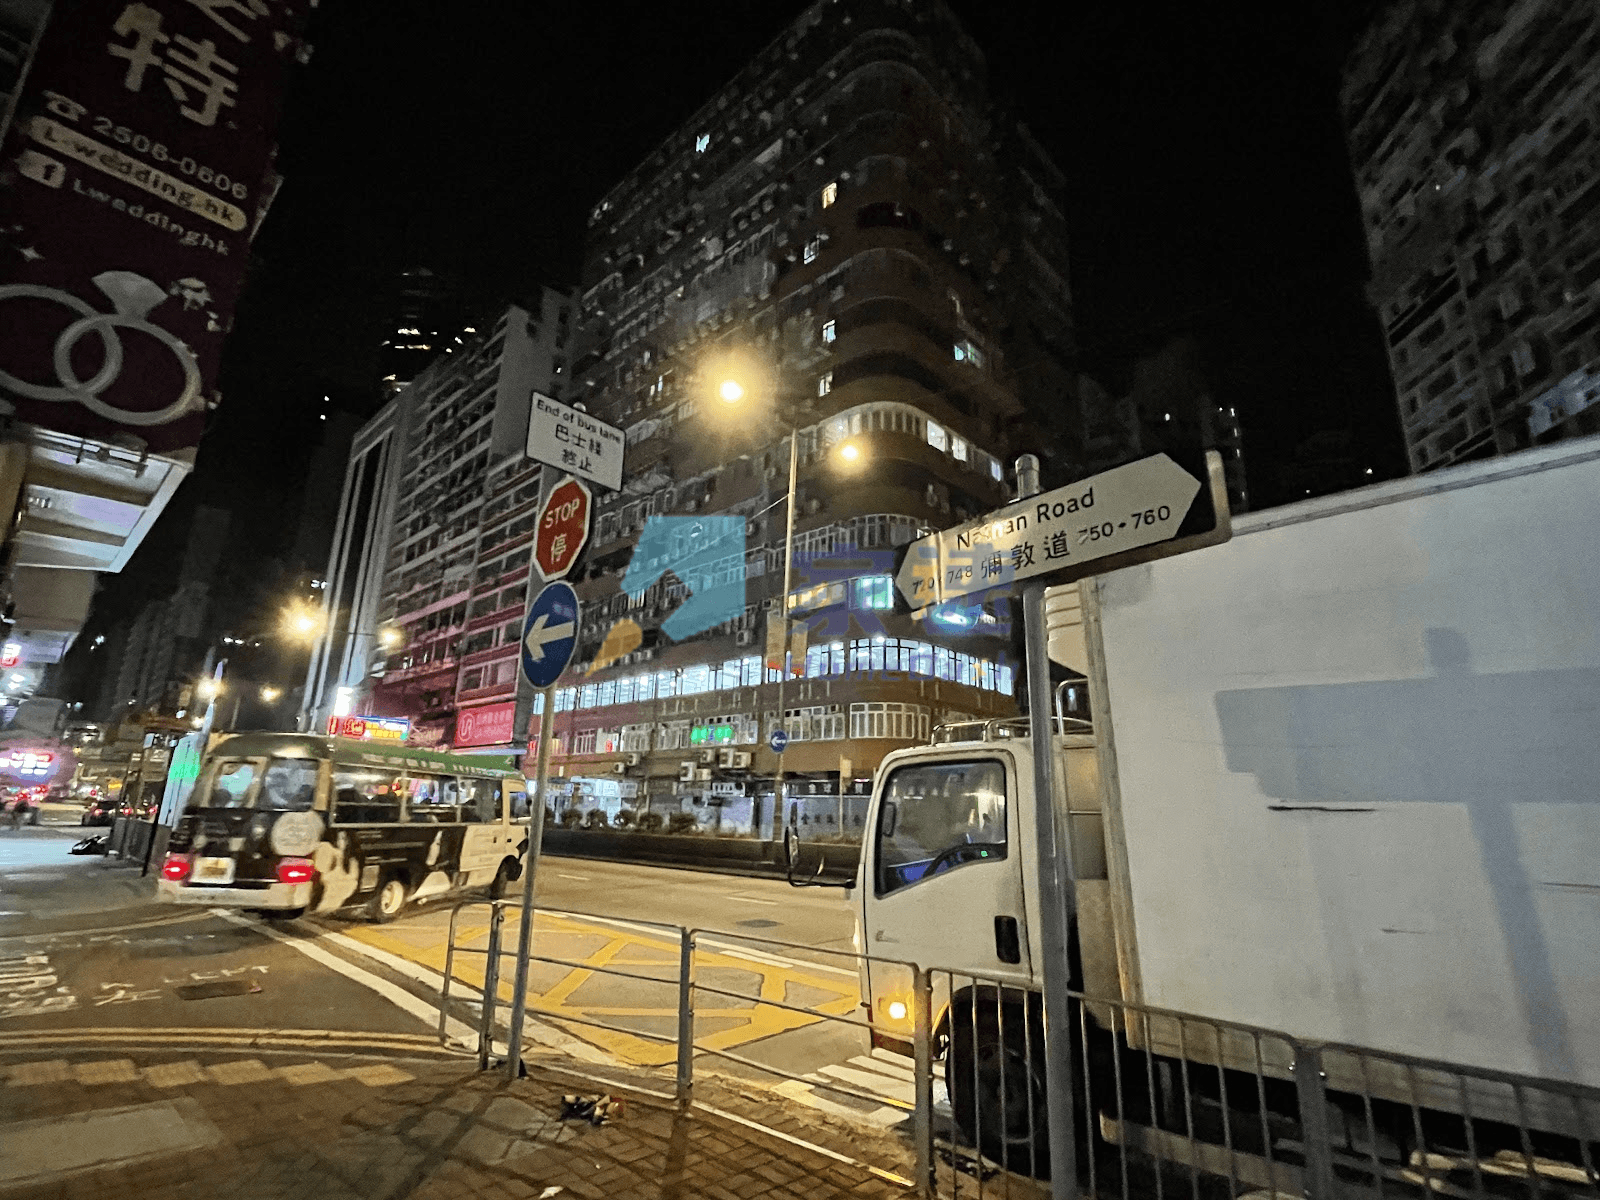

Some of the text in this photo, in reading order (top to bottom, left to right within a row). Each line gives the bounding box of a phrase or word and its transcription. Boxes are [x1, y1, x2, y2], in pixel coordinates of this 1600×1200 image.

[537, 399, 560, 417] End
[562, 412, 575, 423] of
[577, 414, 598, 433] bus
[545, 497, 581, 529] STOP
[1036, 487, 1095, 524] Road
[550, 532, 567, 565] 停
